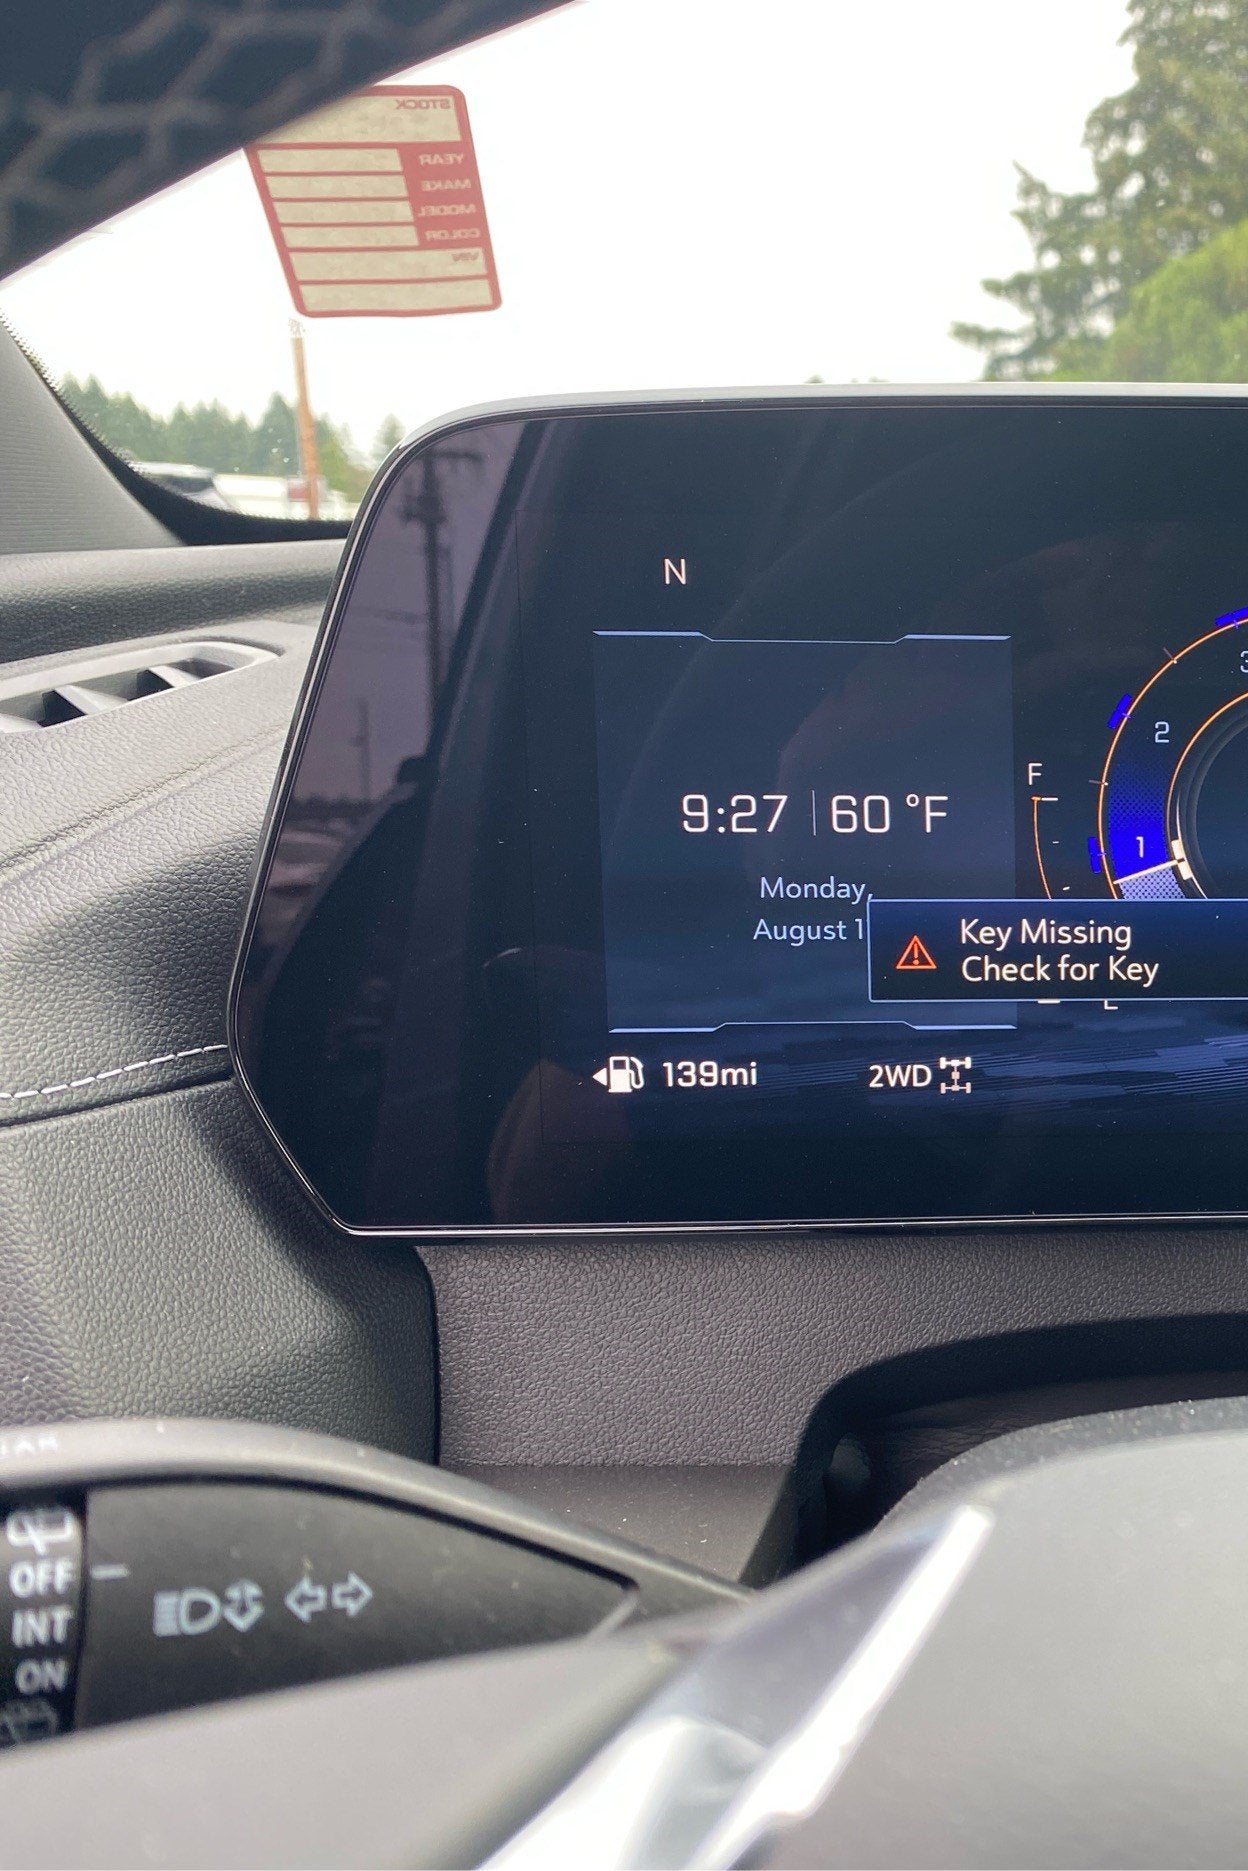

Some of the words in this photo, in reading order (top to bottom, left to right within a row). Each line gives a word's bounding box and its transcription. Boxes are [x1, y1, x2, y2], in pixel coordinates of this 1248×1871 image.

[663, 557, 687, 585] N
[1153, 721, 1171, 744] 2
[1027, 762, 1044, 786] F
[681, 794, 789, 834] 9:27
[1136, 837, 1146, 858] 1
[759, 874, 874, 905] Monday,
[752, 917, 847, 947] August
[960, 918, 1013, 951] Key
[1020, 917, 1132, 951] Missing
[961, 955, 1052, 983] Check
[1057, 953, 1101, 982] for
[1108, 956, 1160, 988] Key
[661, 1060, 758, 1088] 139mi
[868, 1063, 933, 1089] 2WD
[9, 1559, 77, 1598] OFF
[11, 1608, 73, 1648] INT
[15, 1658, 69, 1694] ON
